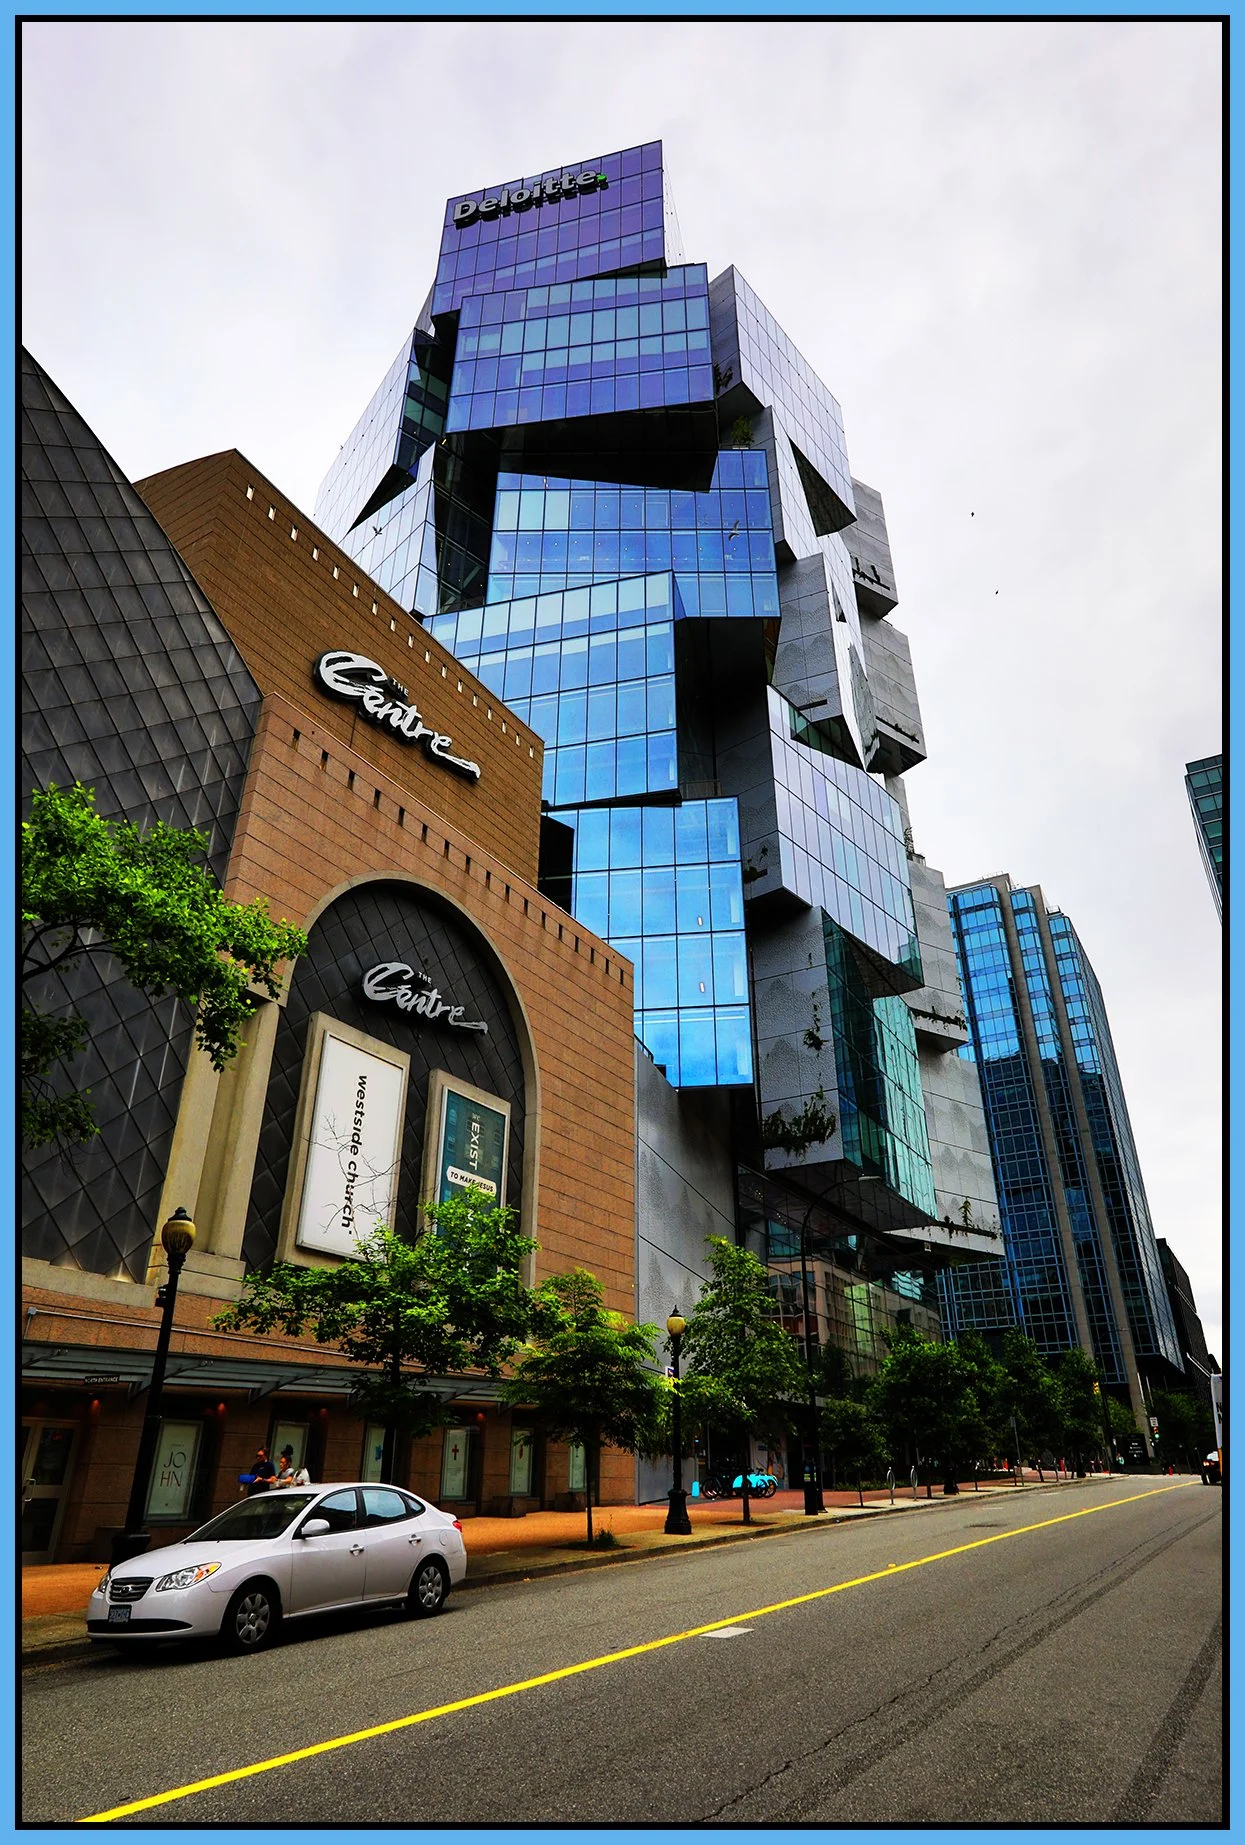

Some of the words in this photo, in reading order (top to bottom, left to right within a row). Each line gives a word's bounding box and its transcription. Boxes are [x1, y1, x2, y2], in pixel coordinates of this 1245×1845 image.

[392, 677, 409, 697] THE
[316, 650, 481, 779] Centre
[363, 961, 488, 1034] Centre
[418, 971, 432, 985] THE
[350, 1075, 367, 1156] westside
[469, 1121, 480, 1171] EXIST
[450, 1171, 459, 1180] TO
